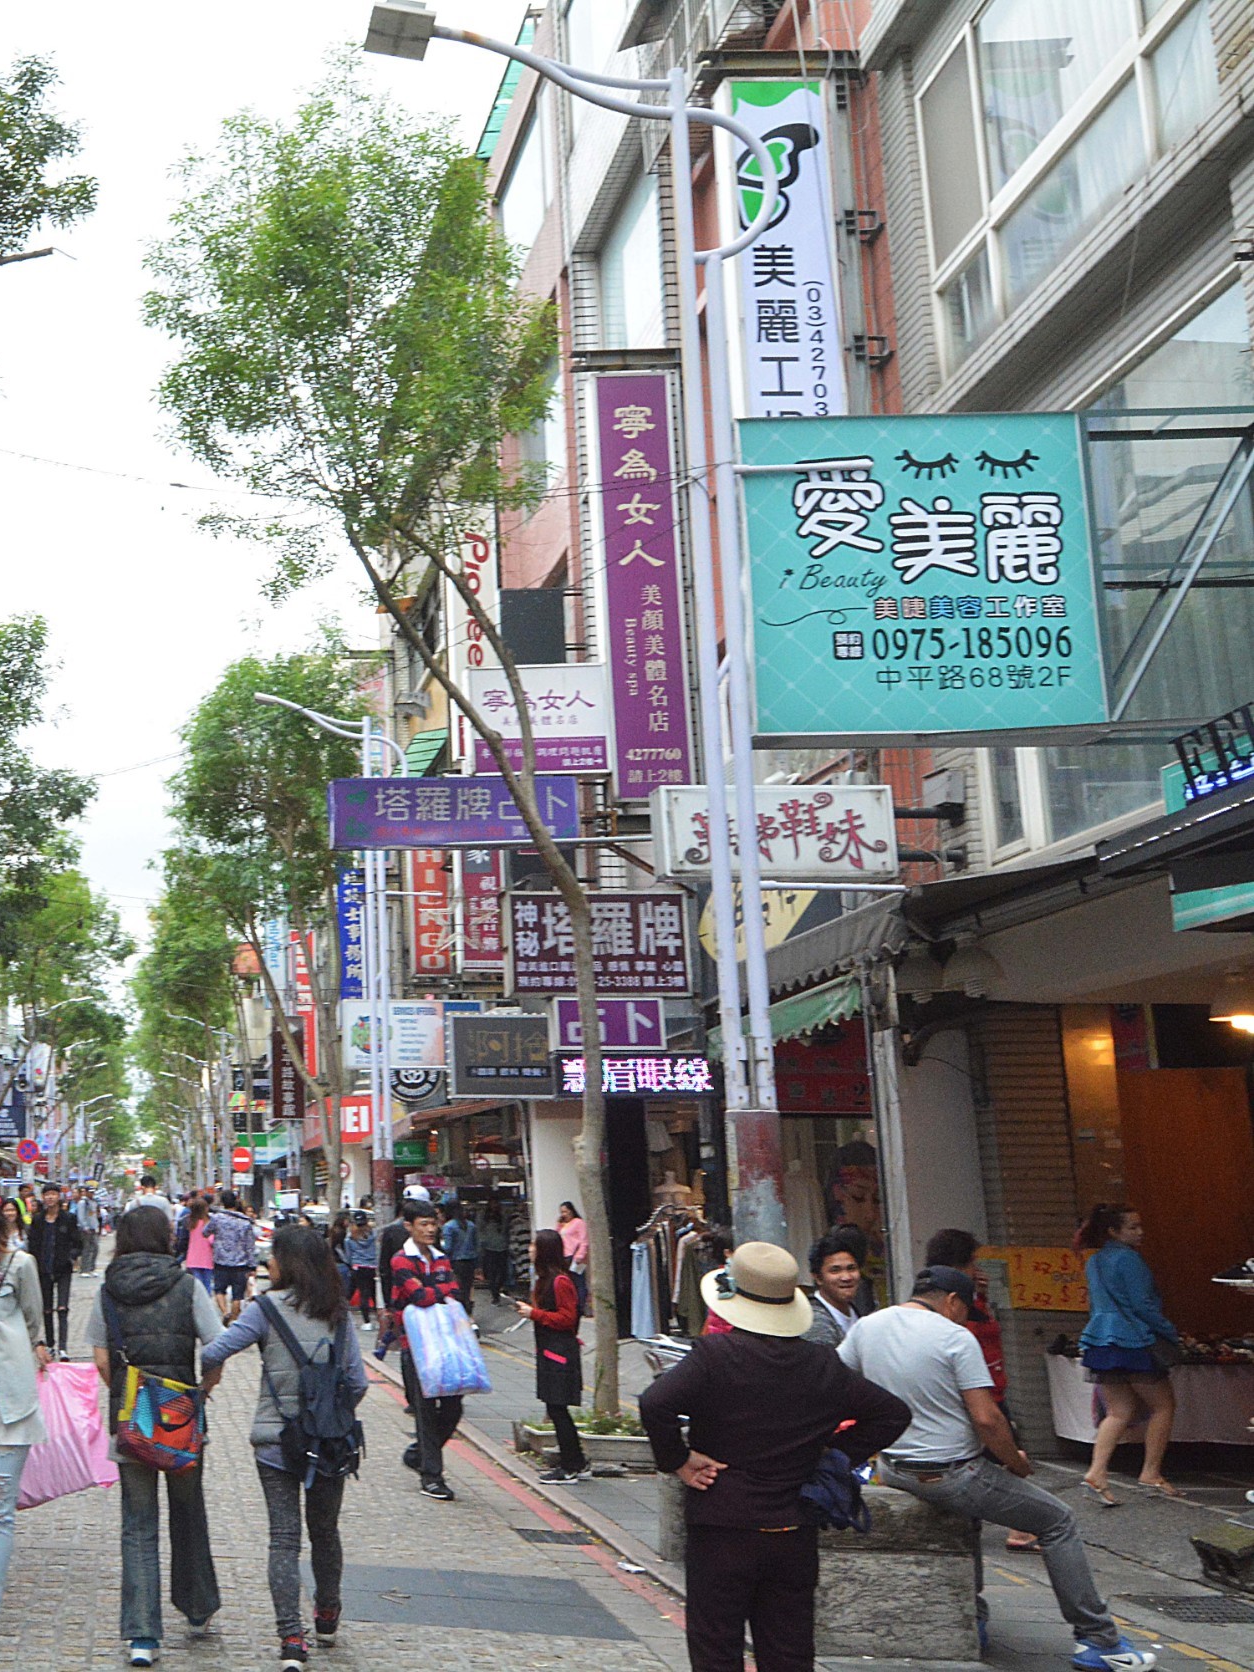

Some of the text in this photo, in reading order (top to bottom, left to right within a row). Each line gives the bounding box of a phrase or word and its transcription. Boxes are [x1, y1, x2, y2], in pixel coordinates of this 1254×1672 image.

[752, 244, 803, 416] 美麗工
[793, 455, 1063, 585] 愛美麗
[799, 564, 888, 597] Beauty
[873, 595, 1067, 621] 美睫美容工作室
[872, 625, 1073, 662] 0975-185096
[625, 747, 683, 762] 4277760
